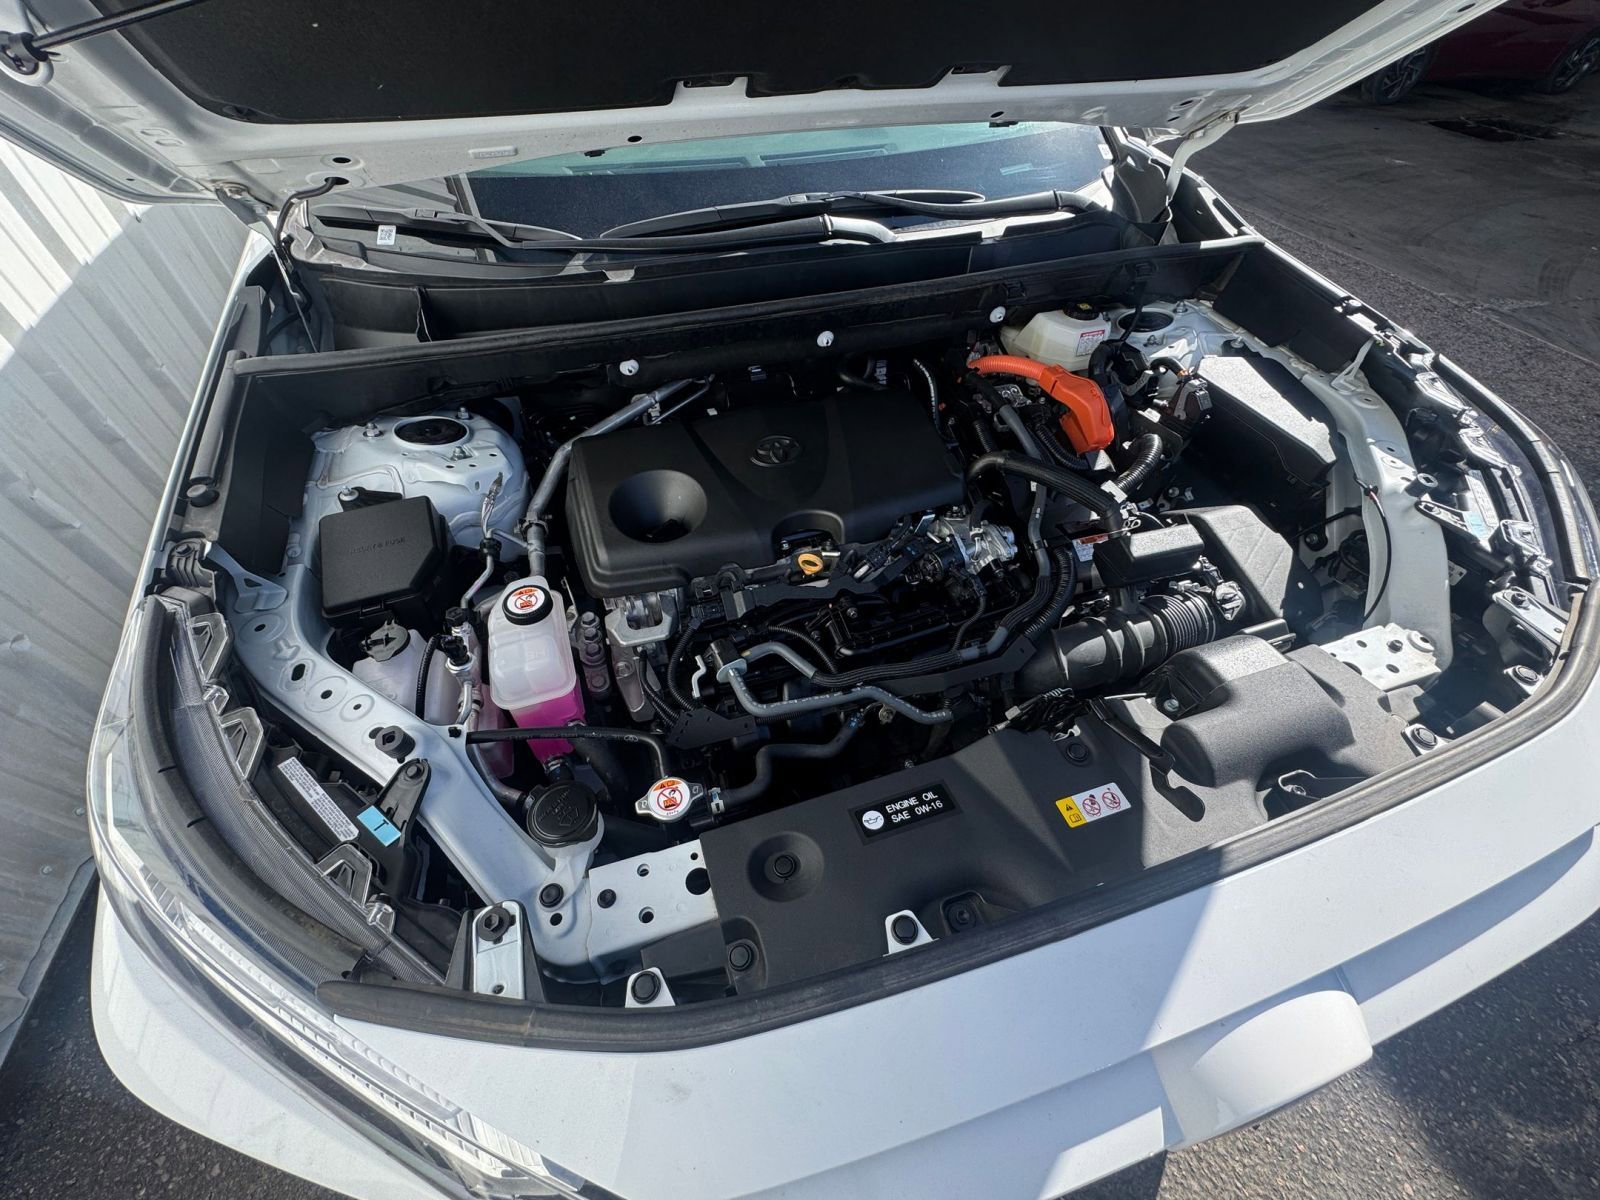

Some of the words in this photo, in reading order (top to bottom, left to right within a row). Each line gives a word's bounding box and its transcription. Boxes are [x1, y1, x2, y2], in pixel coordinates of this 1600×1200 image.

[885, 796, 919, 813] ENGINE
[922, 791, 938, 801] OIL
[891, 810, 911, 823] SAE
[914, 800, 943, 815] 0W-16
[373, 819, 389, 832] T
